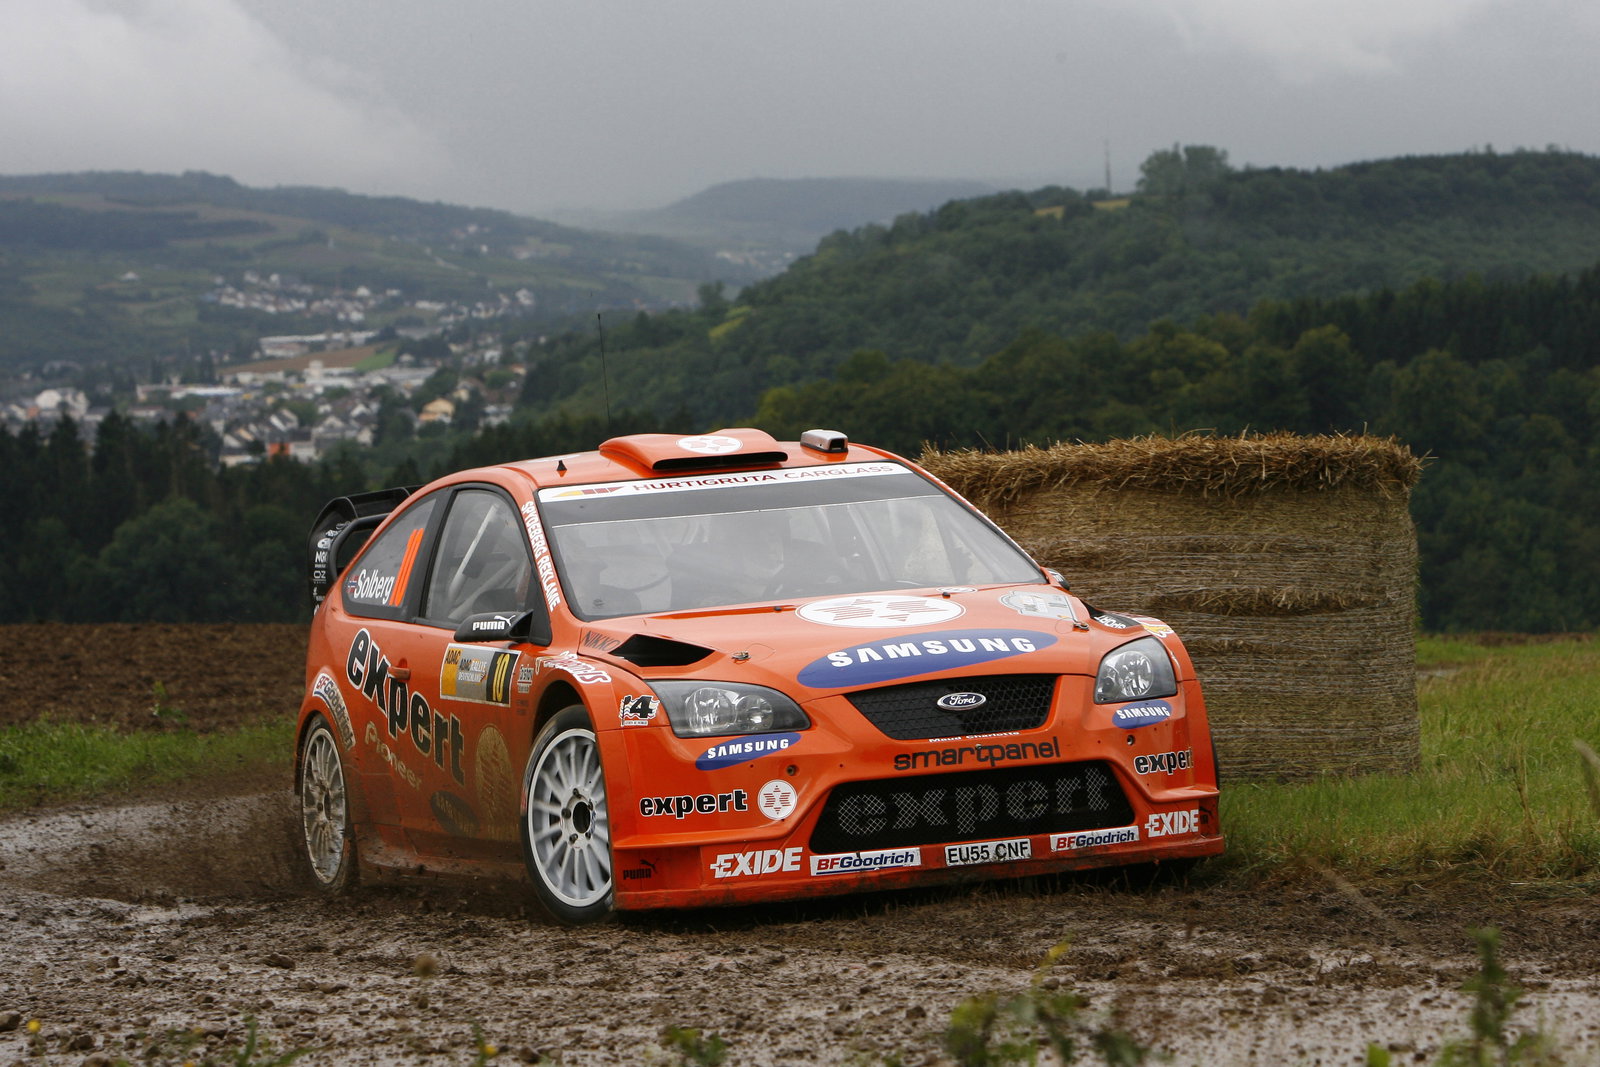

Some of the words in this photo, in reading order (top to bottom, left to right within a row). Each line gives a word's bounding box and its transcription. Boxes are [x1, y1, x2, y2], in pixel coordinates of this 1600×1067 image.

[633, 473, 777, 492] HURTIGRUTA
[784, 465, 894, 480] CARGLASS
[521, 501, 548, 560] SPYDEBERG
[537, 556, 561, 612] REKLAME
[354, 569, 395, 605] Solberg
[472, 620, 505, 631] PUMA
[581, 630, 622, 651] NIKKO
[827, 637, 1036, 667] SAMSUNG
[492, 653, 510, 702] 10
[346, 628, 465, 788] expert
[948, 694, 977, 707] Ford
[1116, 706, 1171, 720] SAMSUNG
[707, 738, 789, 759] SAMSUNG
[894, 737, 1061, 770] smartpanel
[639, 789, 748, 819] expert
[838, 767, 1109, 835] expert
[1145, 809, 1199, 838] EXIDE
[947, 843, 990, 864] EU55
[996, 840, 1029, 860] CNF
[1056, 830, 1135, 849] BFGoodrich
[622, 868, 652, 880] PUMA
[710, 846, 803, 878] EXIDE
[816, 851, 915, 872] BFGoodrich
